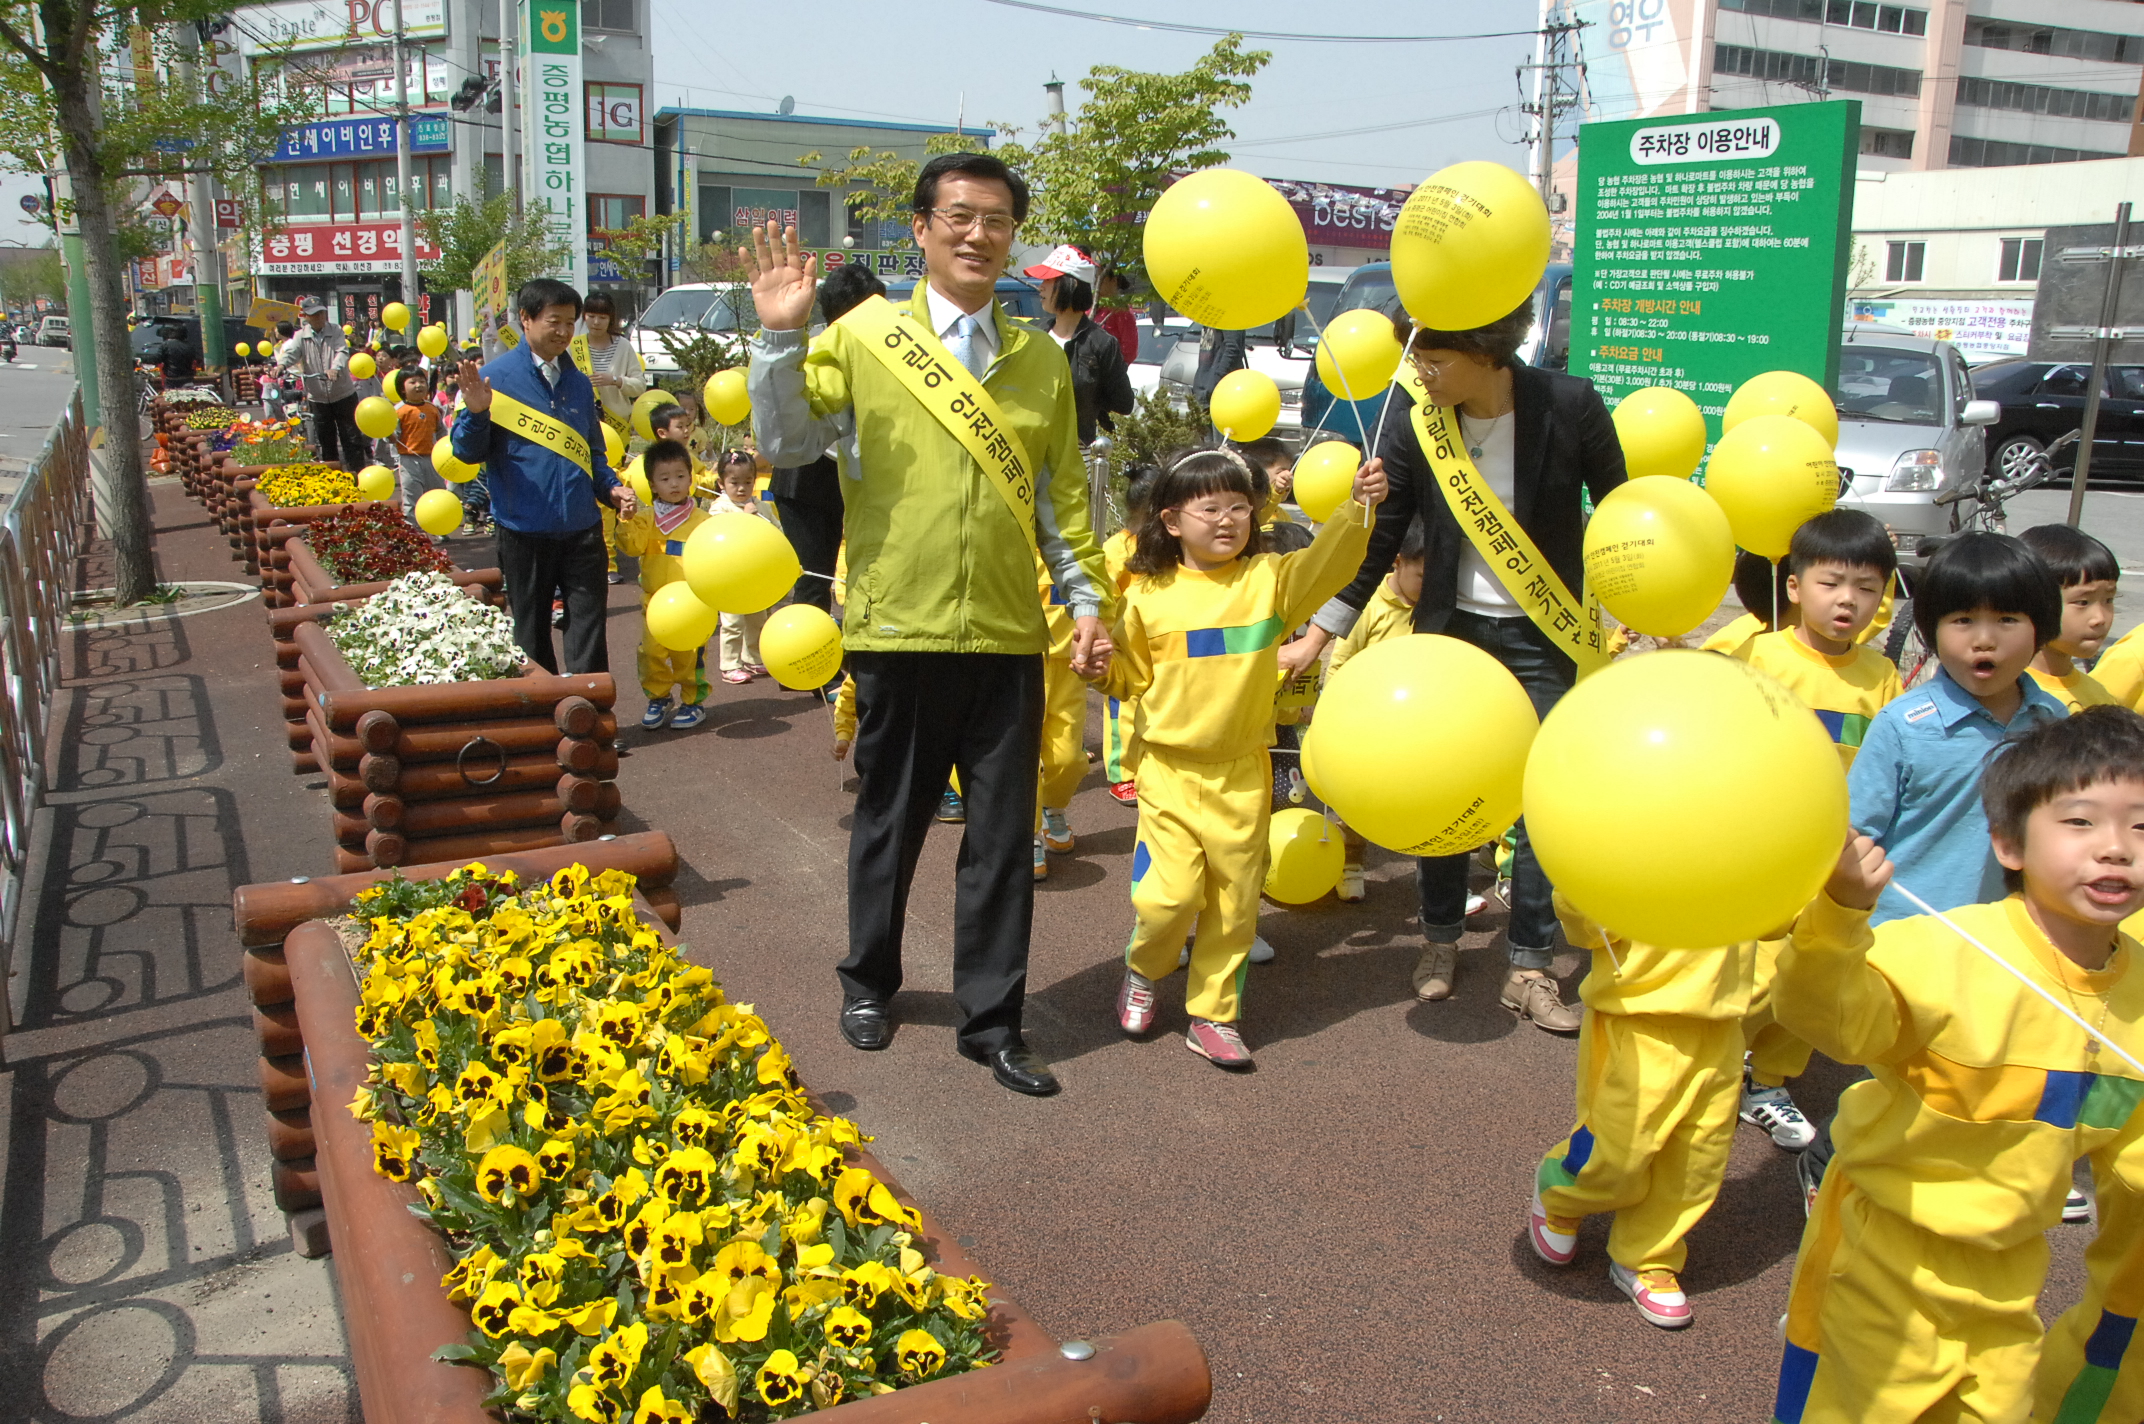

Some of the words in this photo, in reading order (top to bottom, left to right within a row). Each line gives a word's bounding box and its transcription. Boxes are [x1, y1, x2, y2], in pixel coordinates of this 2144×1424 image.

[269, 17, 317, 38] Sante
[1639, 132, 1690, 158] 주차장
[1697, 125, 1770, 153] 이용안내
[1606, 175, 1620, 186] 농협
[1621, 174, 1648, 185] 주차장은
[1650, 173, 1664, 184] 농협
[1674, 170, 1717, 182] 하나로마트를
[1719, 168, 1756, 180] 이용하시는
[1757, 166, 1781, 178] 고객을
[1783, 165, 1807, 177] 위하여
[1597, 187, 1618, 197] 조성한
[1619, 185, 1661, 197] 주차장입니다.
[1665, 184, 1679, 194] 마트
[1707, 181, 1736, 193] 불법주차
[1790, 177, 1815, 190] 농협을
[1460, 193, 1493, 219] 걷기대회
[1597, 198, 1630, 209] 이용하시는
[1631, 196, 1658, 207] 고객들의
[1696, 194, 1718, 206] 상당히
[1719, 193, 1749, 205] 발생하고
[1775, 191, 1800, 203] 부득이
[218, 203, 242, 226] 약
[1596, 209, 1619, 220] 2004년
[1621, 208, 1632, 219] 1월
[1633, 208, 1664, 219] 1일부터는
[1665, 207, 1700, 218] 불법주차를
[1702, 205, 1732, 217] 허용하지
[1732, 204, 1773, 217] 않겠습니다.
[1595, 228, 1622, 239] 불법주차
[1683, 225, 1718, 237] 주차요금을
[1720, 225, 1774, 237] 징수하겠습니다.
[269, 232, 313, 256] 증평
[1606, 239, 1620, 250] 농협
[1629, 239, 1664, 249] 하나로마트
[1751, 237, 1782, 248] 대하여는
[1783, 237, 1810, 248] 60분에
[1594, 250, 1614, 261] 한하여
[1615, 250, 1648, 261] 주차요금을
[1650, 250, 1664, 261] 받지
[1665, 250, 1702, 261] 않겠습니다.
[1694, 269, 1724, 280] 무료주차
[1724, 269, 1755, 281] 허용불가
[1601, 298, 1632, 313] 주차장
[1635, 299, 1677, 314] 개방시간
[1679, 300, 1701, 315] 안내
[1618, 317, 1639, 327] 08:30
[1647, 318, 1669, 328] 22:00
[1908, 316, 1935, 326] 증평농협
[1937, 317, 1966, 326] 중앙지점
[1966, 315, 2007, 329] 고객전용
[1665, 330, 1688, 340] 20:00
[1747, 334, 1770, 345] 19:00
[1955, 330, 1993, 340] 스티커부착
[573, 338, 586, 362] 어린이
[1598, 345, 1639, 361] 주차요금
[1642, 347, 1663, 362] 안내
[1588, 363, 1615, 373] 이용고객
[884, 325, 954, 389] 어린이
[950, 391, 1034, 506] 안전캠페인
[517, 412, 562, 441] 어린이
[1422, 404, 1456, 460] 어린이
[1449, 469, 1534, 576] 안전캠페인
[1621, 538, 1655, 551] 걷기대회
[1441, 796, 1486, 836] 걷기대회
